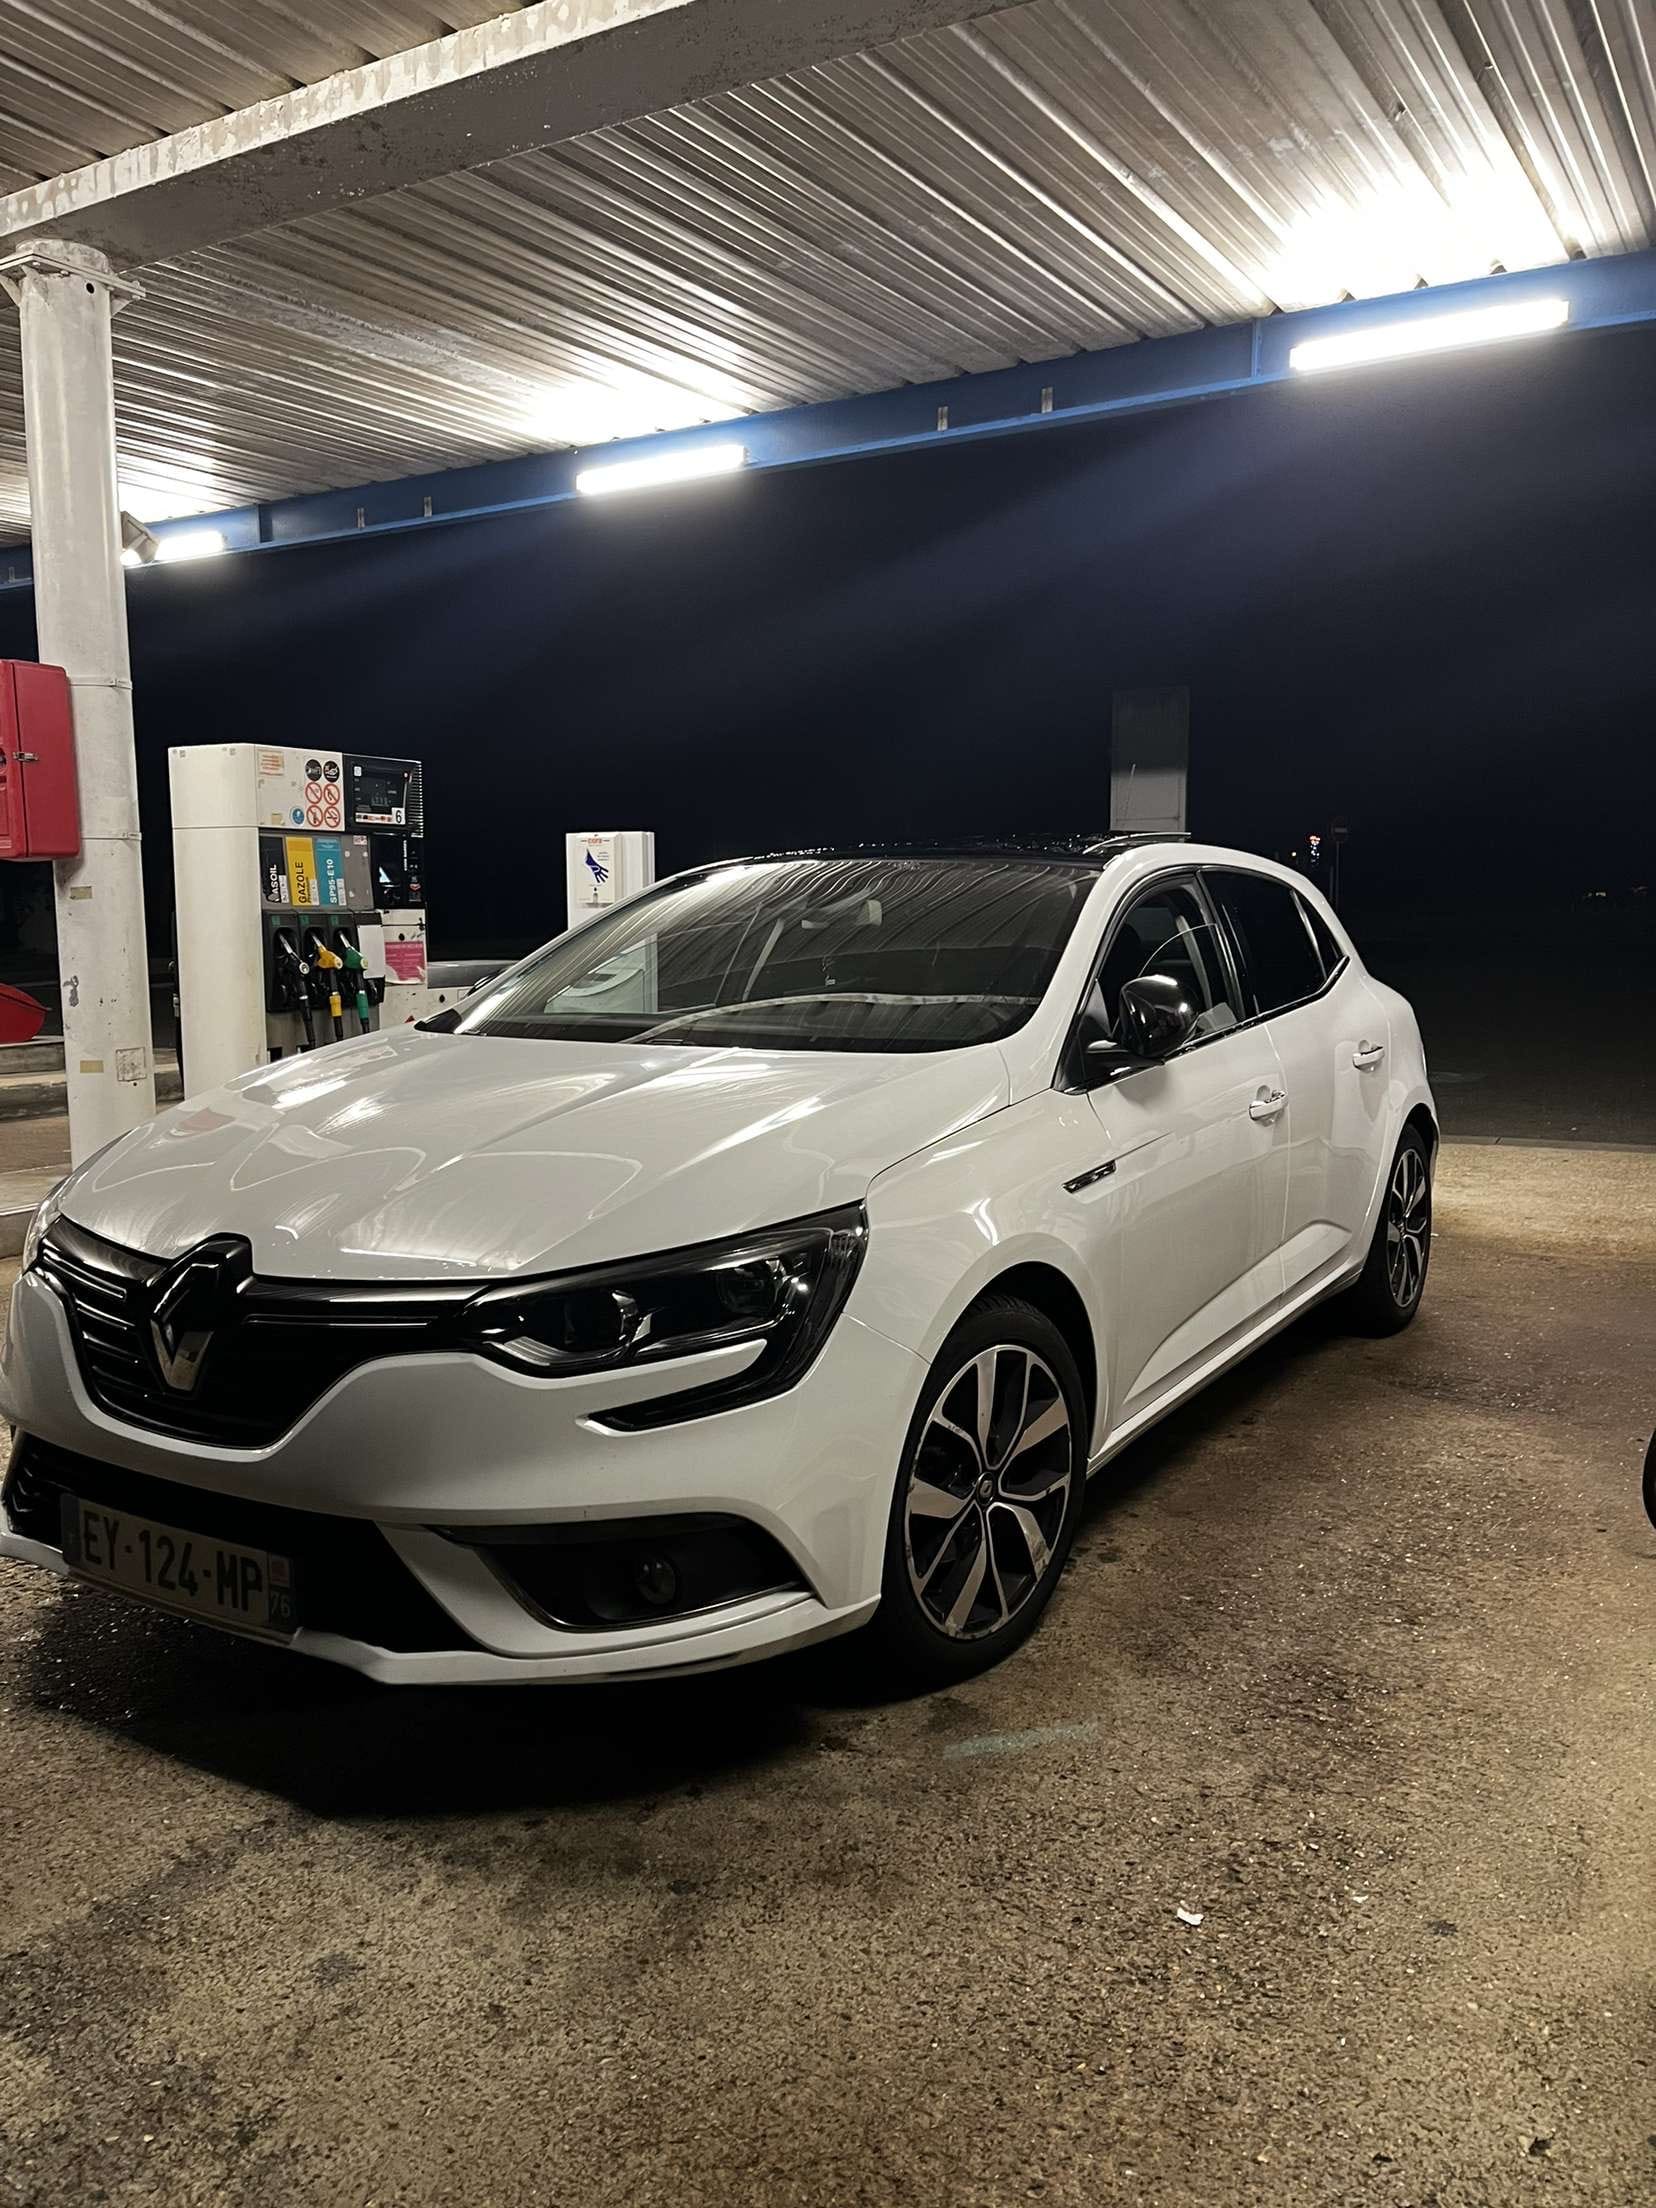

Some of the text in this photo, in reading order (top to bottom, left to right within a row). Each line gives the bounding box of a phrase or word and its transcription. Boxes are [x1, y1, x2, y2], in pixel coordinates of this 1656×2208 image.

[396, 809, 402, 824] 6
[295, 861, 308, 904] GAZOLE
[270, 1591, 291, 1619] 76
